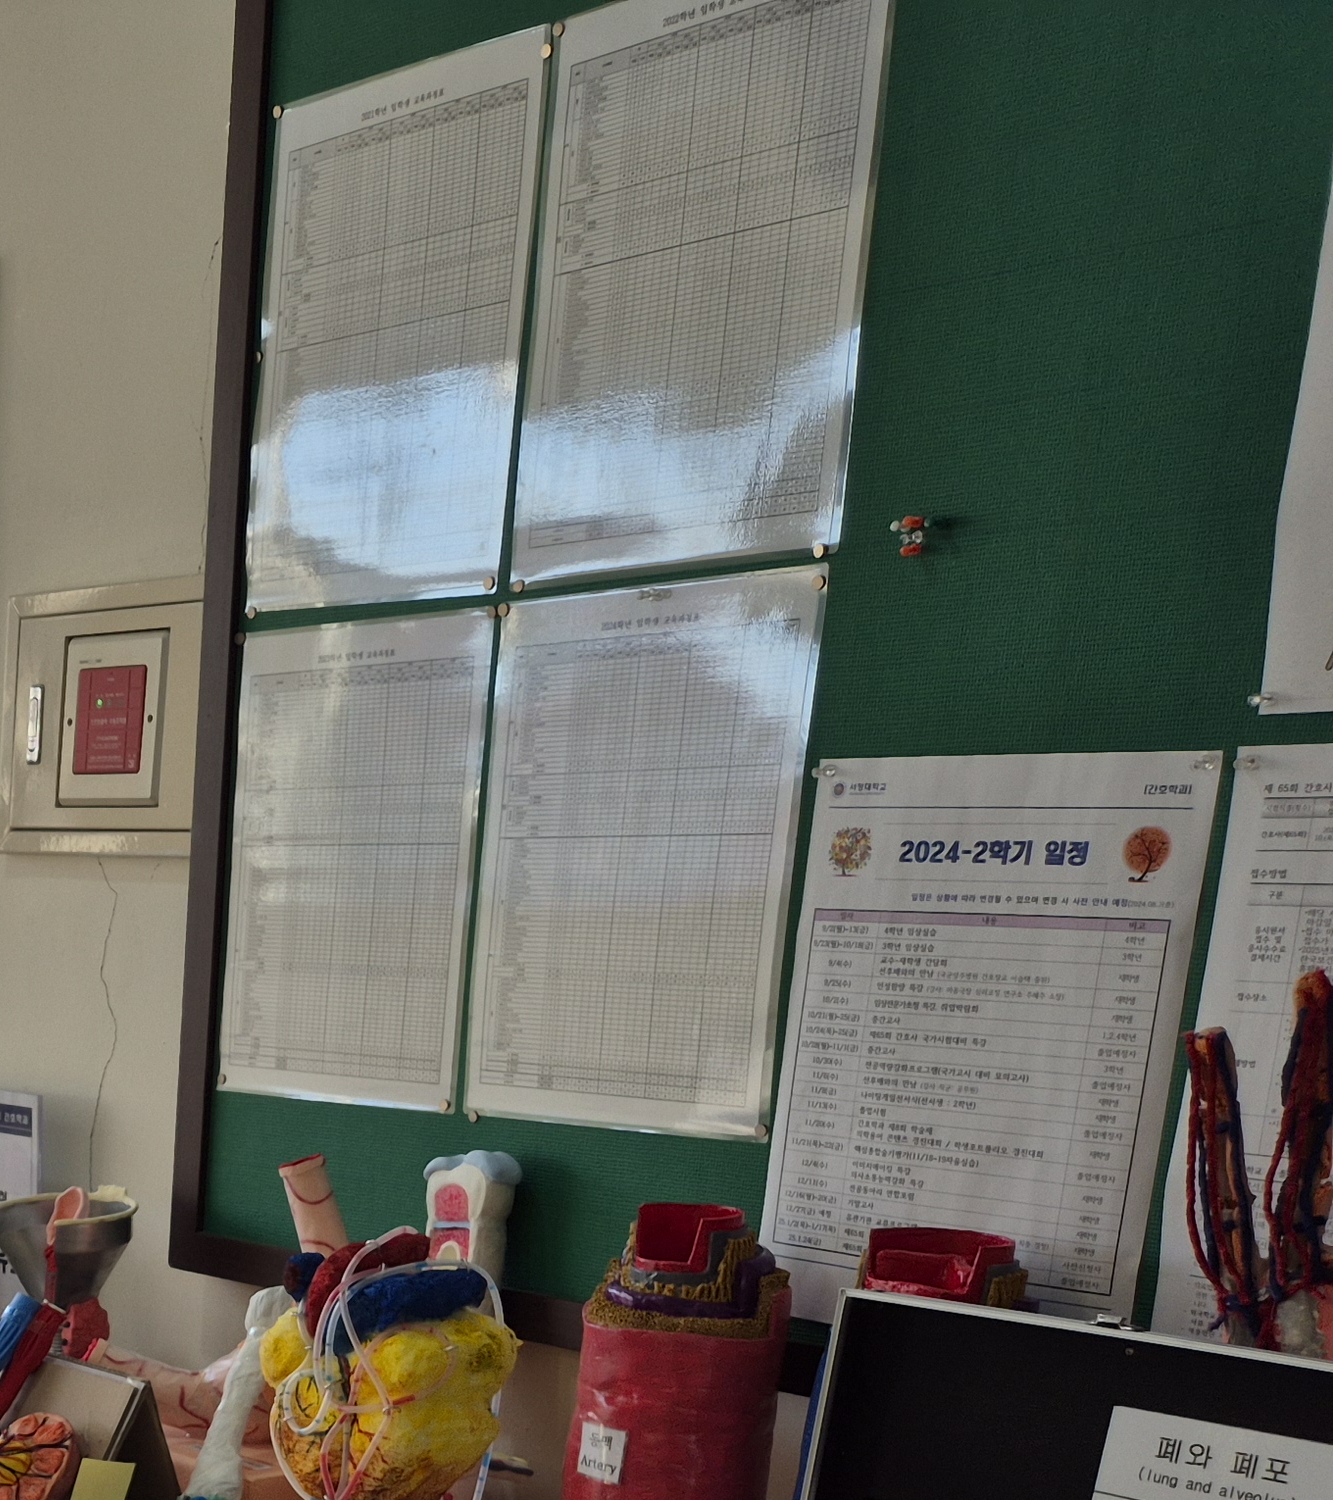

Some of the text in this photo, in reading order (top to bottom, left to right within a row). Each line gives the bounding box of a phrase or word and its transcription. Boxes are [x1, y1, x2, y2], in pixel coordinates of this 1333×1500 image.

[899, 840, 1090, 866] 2024-2학기 일정
[580, 1454, 617, 1476] Artery
[1155, 1436, 1291, 1485] 폐와 폐포
[1138, 1466, 1178, 1488] (lung
[1186, 1479, 1212, 1494] and
